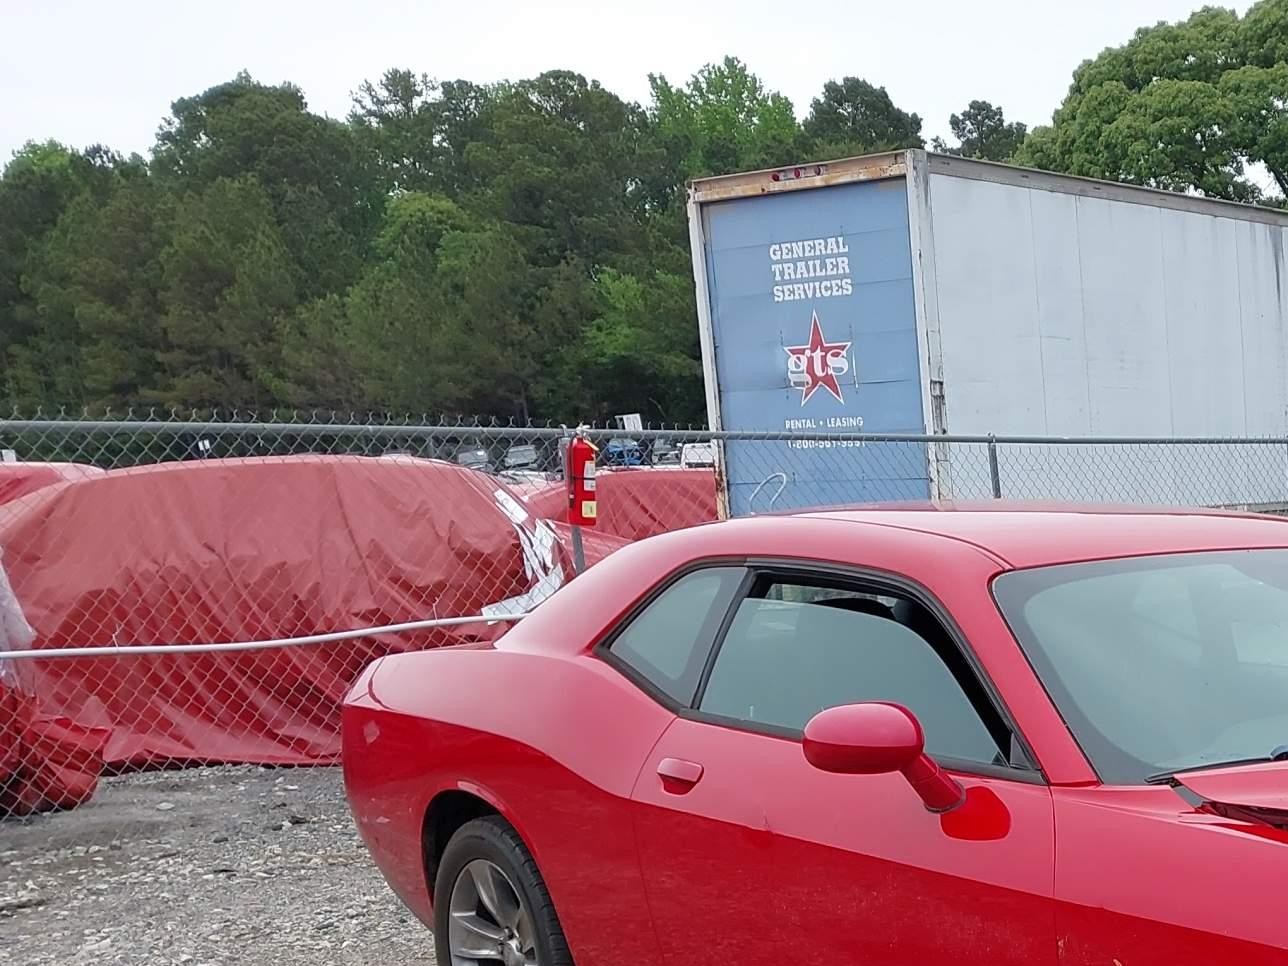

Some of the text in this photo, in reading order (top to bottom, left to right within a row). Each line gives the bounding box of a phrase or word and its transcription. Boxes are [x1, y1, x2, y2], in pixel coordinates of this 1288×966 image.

[769, 236, 849, 261] GENERAL
[771, 257, 850, 281] TRAILER
[773, 278, 853, 302] SERVICES
[788, 345, 849, 390] gts
[785, 416, 864, 430] RENTAL LEASING
